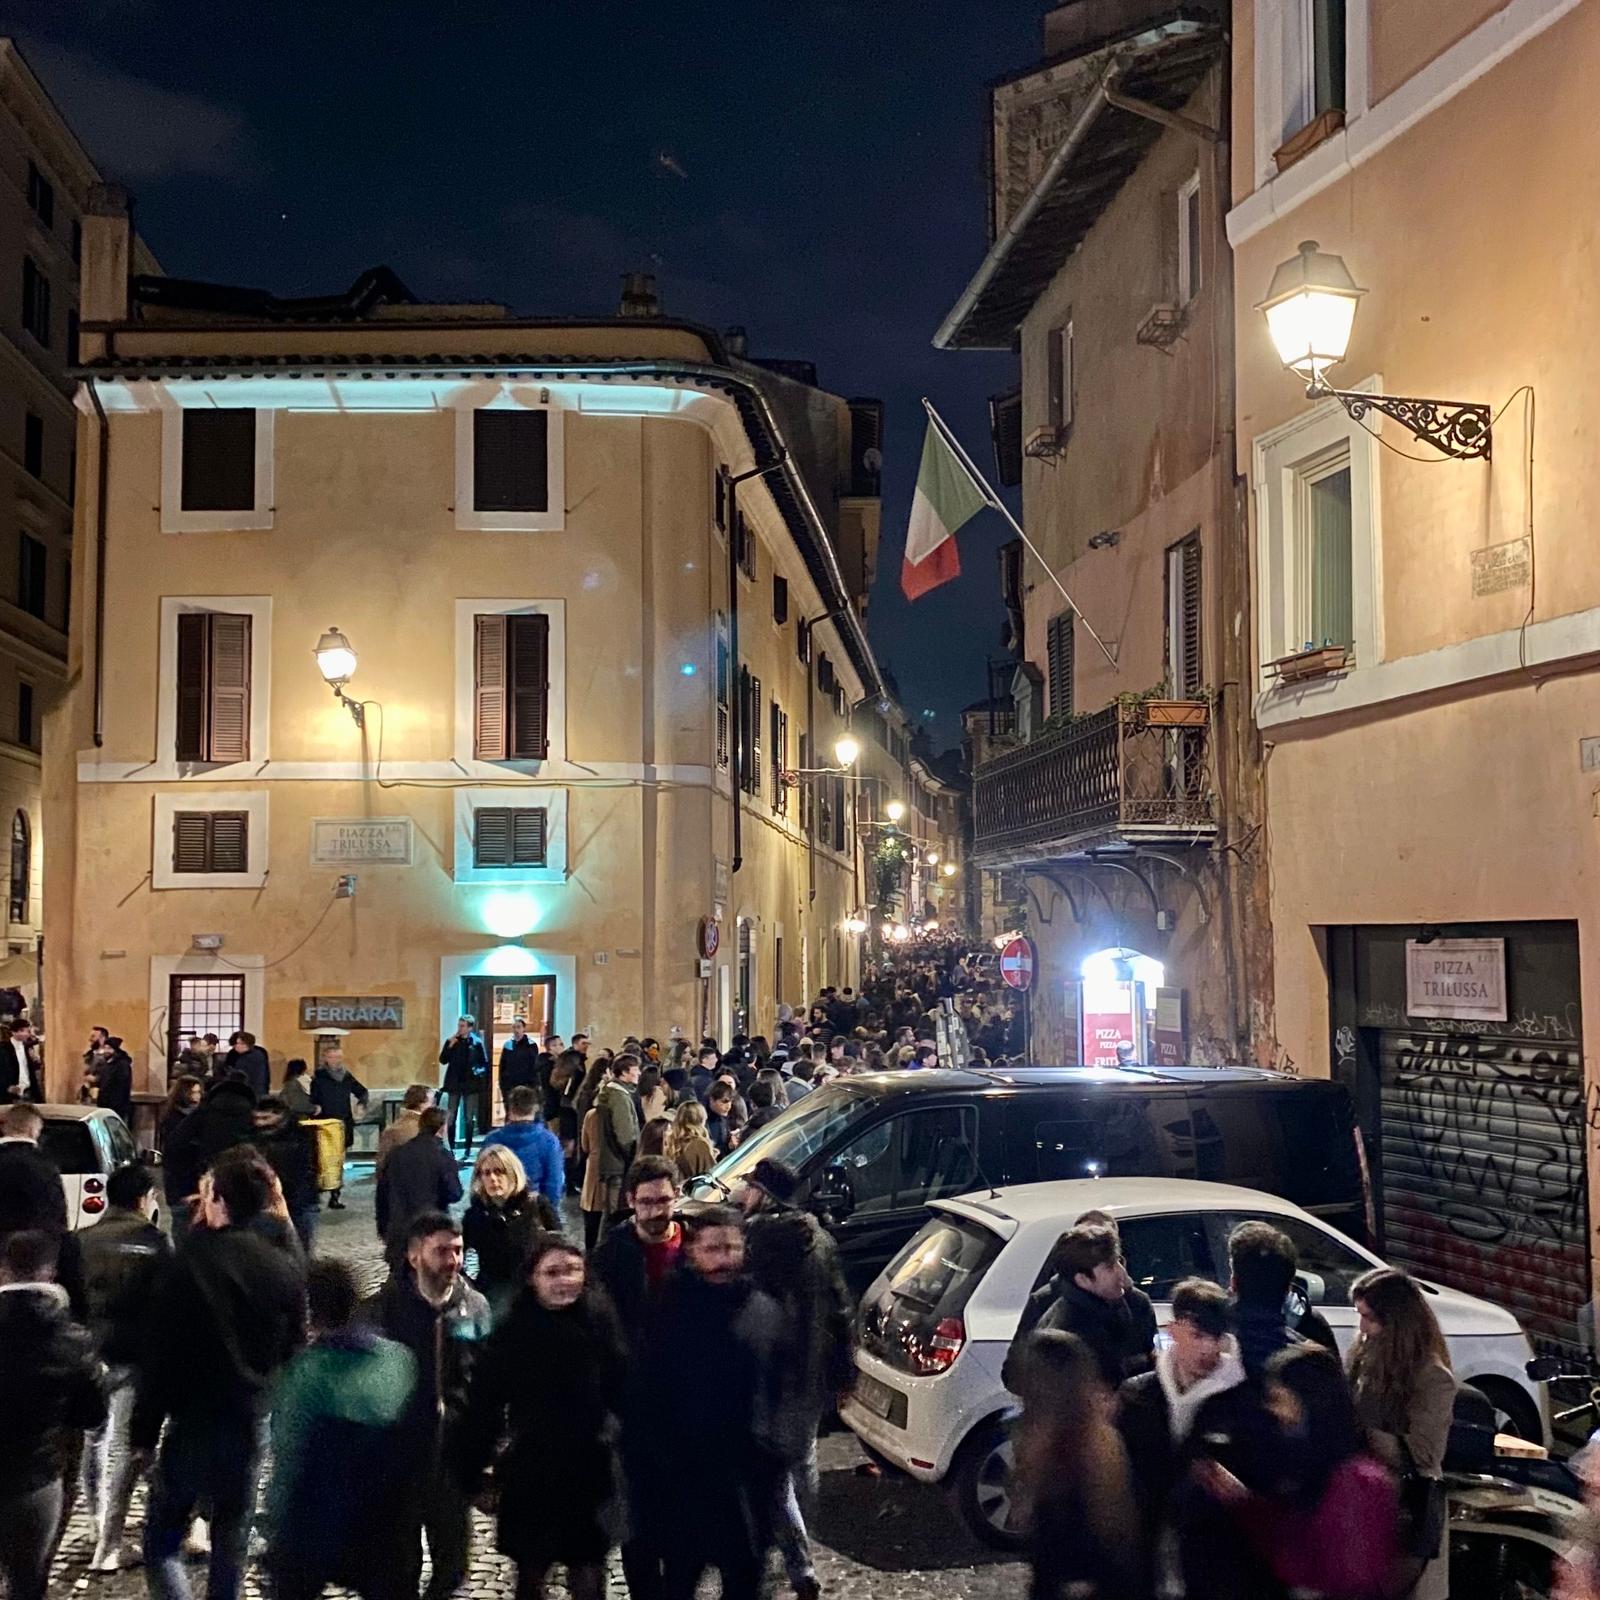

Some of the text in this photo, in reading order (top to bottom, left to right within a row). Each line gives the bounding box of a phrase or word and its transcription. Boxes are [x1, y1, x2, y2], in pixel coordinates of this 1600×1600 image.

[339, 828, 384, 838] PIAZZA
[331, 839, 391, 849] TRILUSSA
[1434, 961, 1474, 975] PIZZA
[1423, 981, 1488, 998] TRILUSSA
[304, 1007, 398, 1021] FERRARA
[1095, 1029, 1121, 1039] PIZZA
[1161, 1043, 1177, 1055] PIZZA
